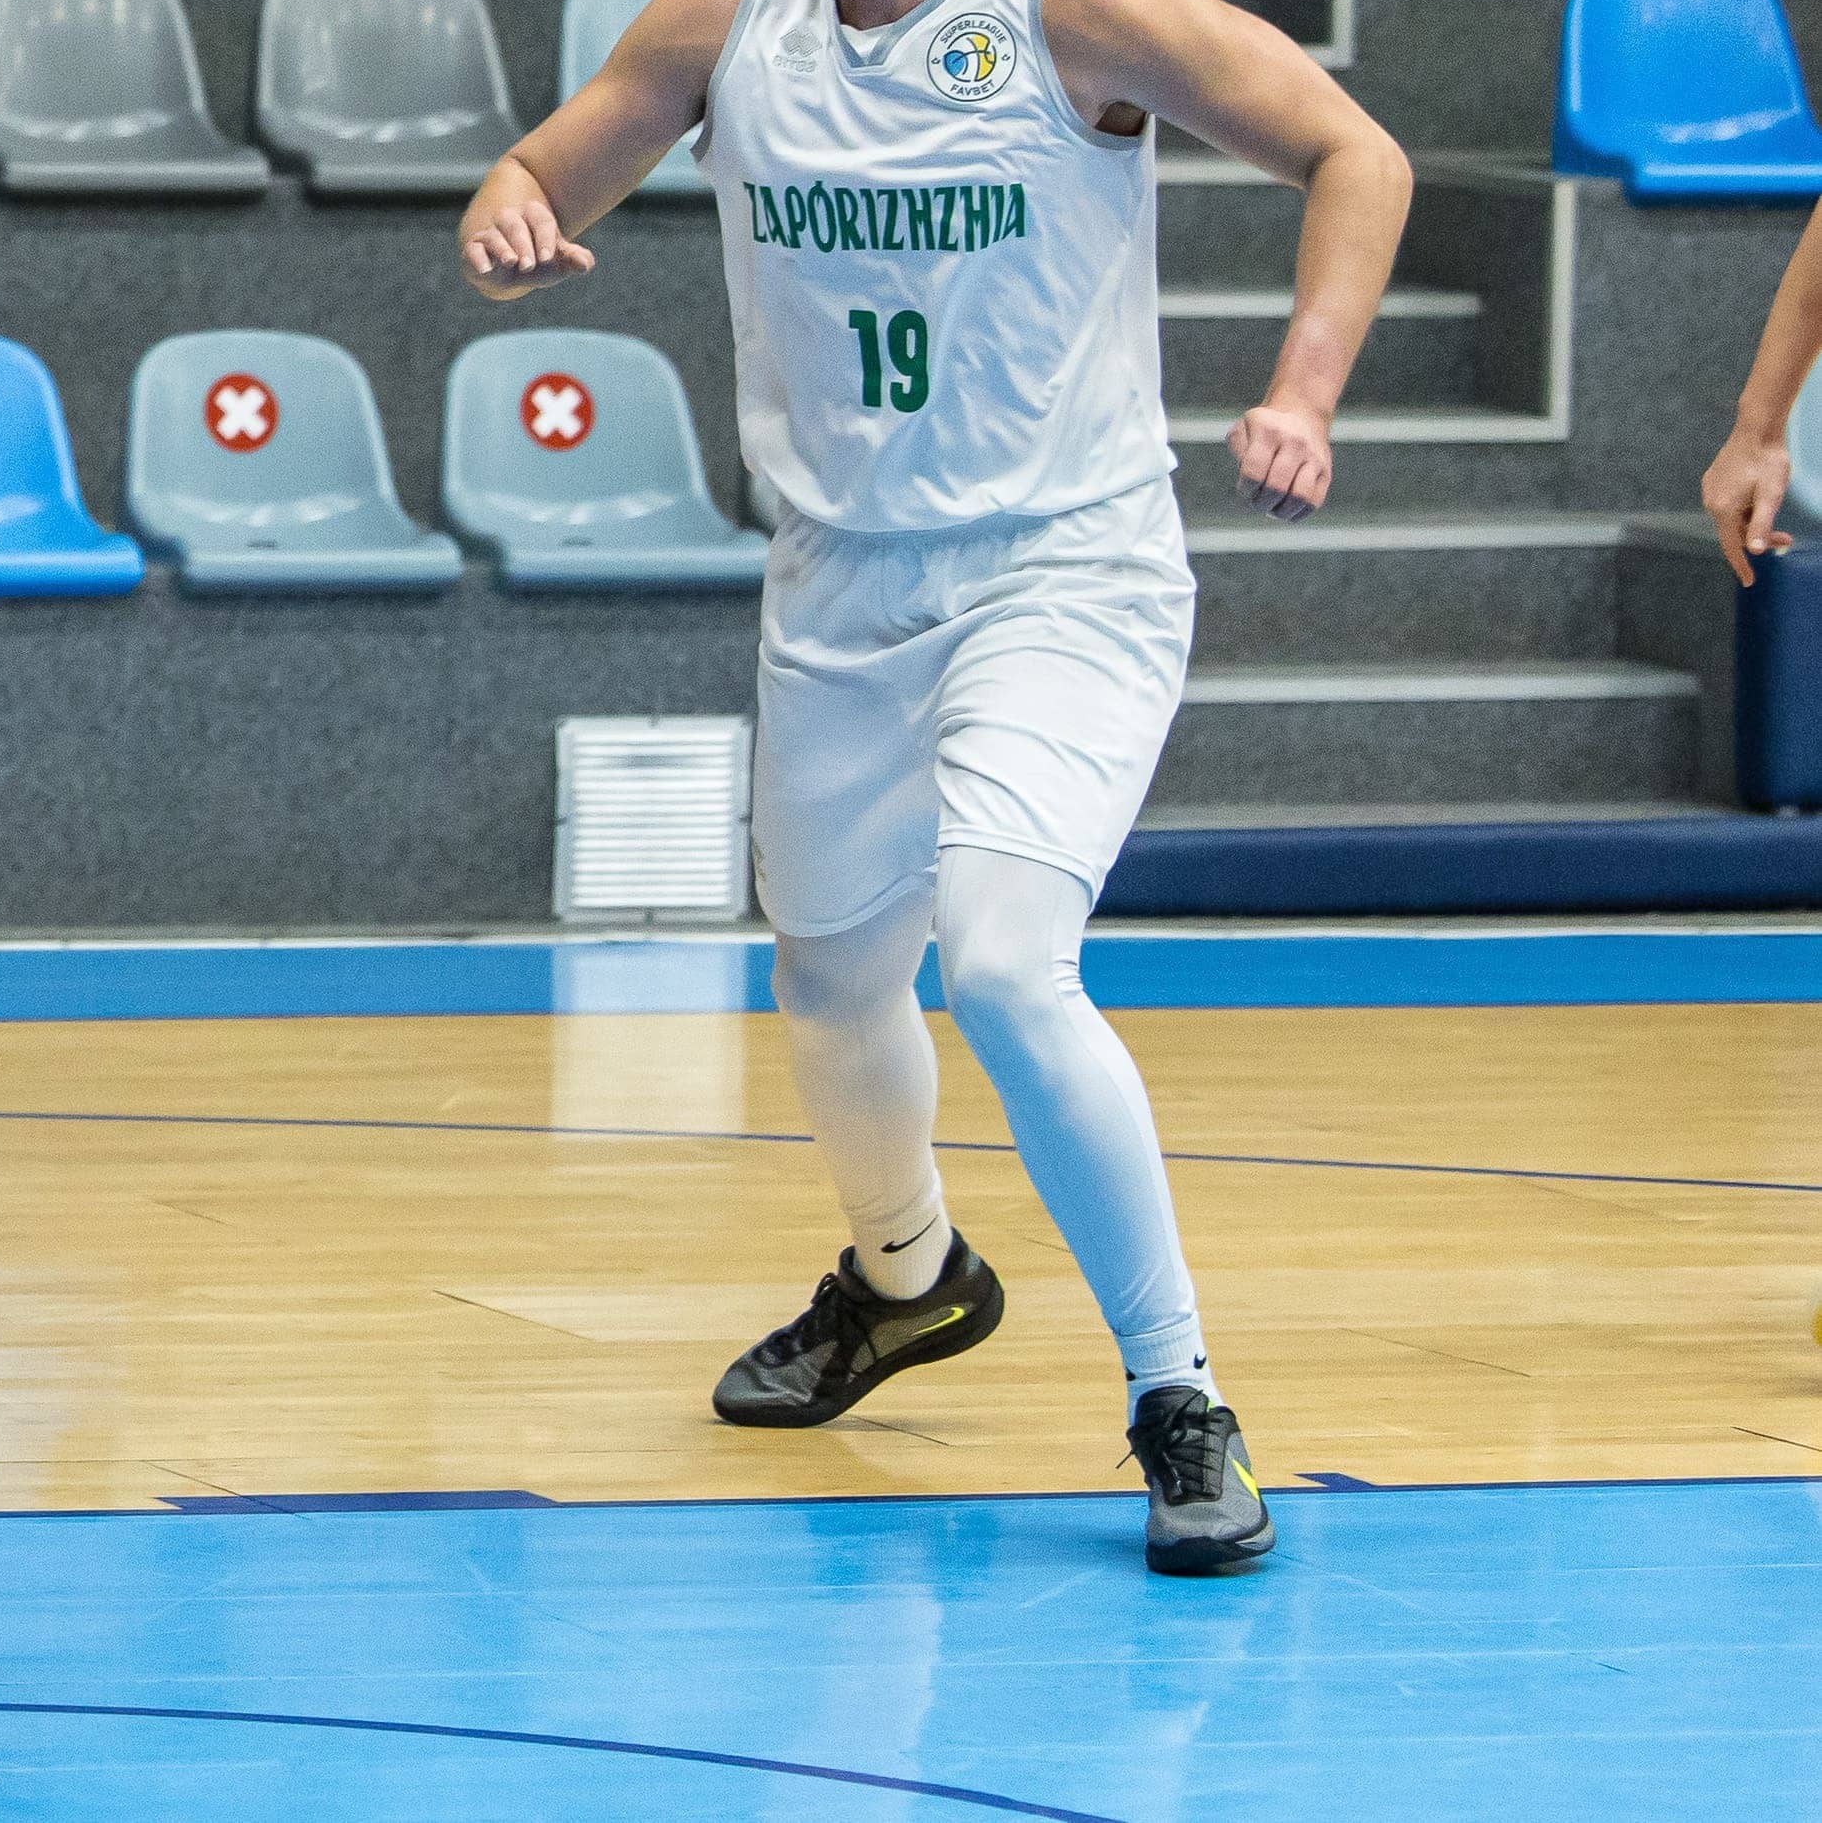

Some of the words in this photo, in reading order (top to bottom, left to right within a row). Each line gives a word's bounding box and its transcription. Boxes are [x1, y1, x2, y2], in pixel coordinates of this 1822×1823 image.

[939, 19, 1009, 45] SUPERLEAGUE
[950, 79, 997, 97] FAVBET
[743, 180, 1026, 253] ZAPORIZHZHIA
[848, 309, 930, 413] 19
